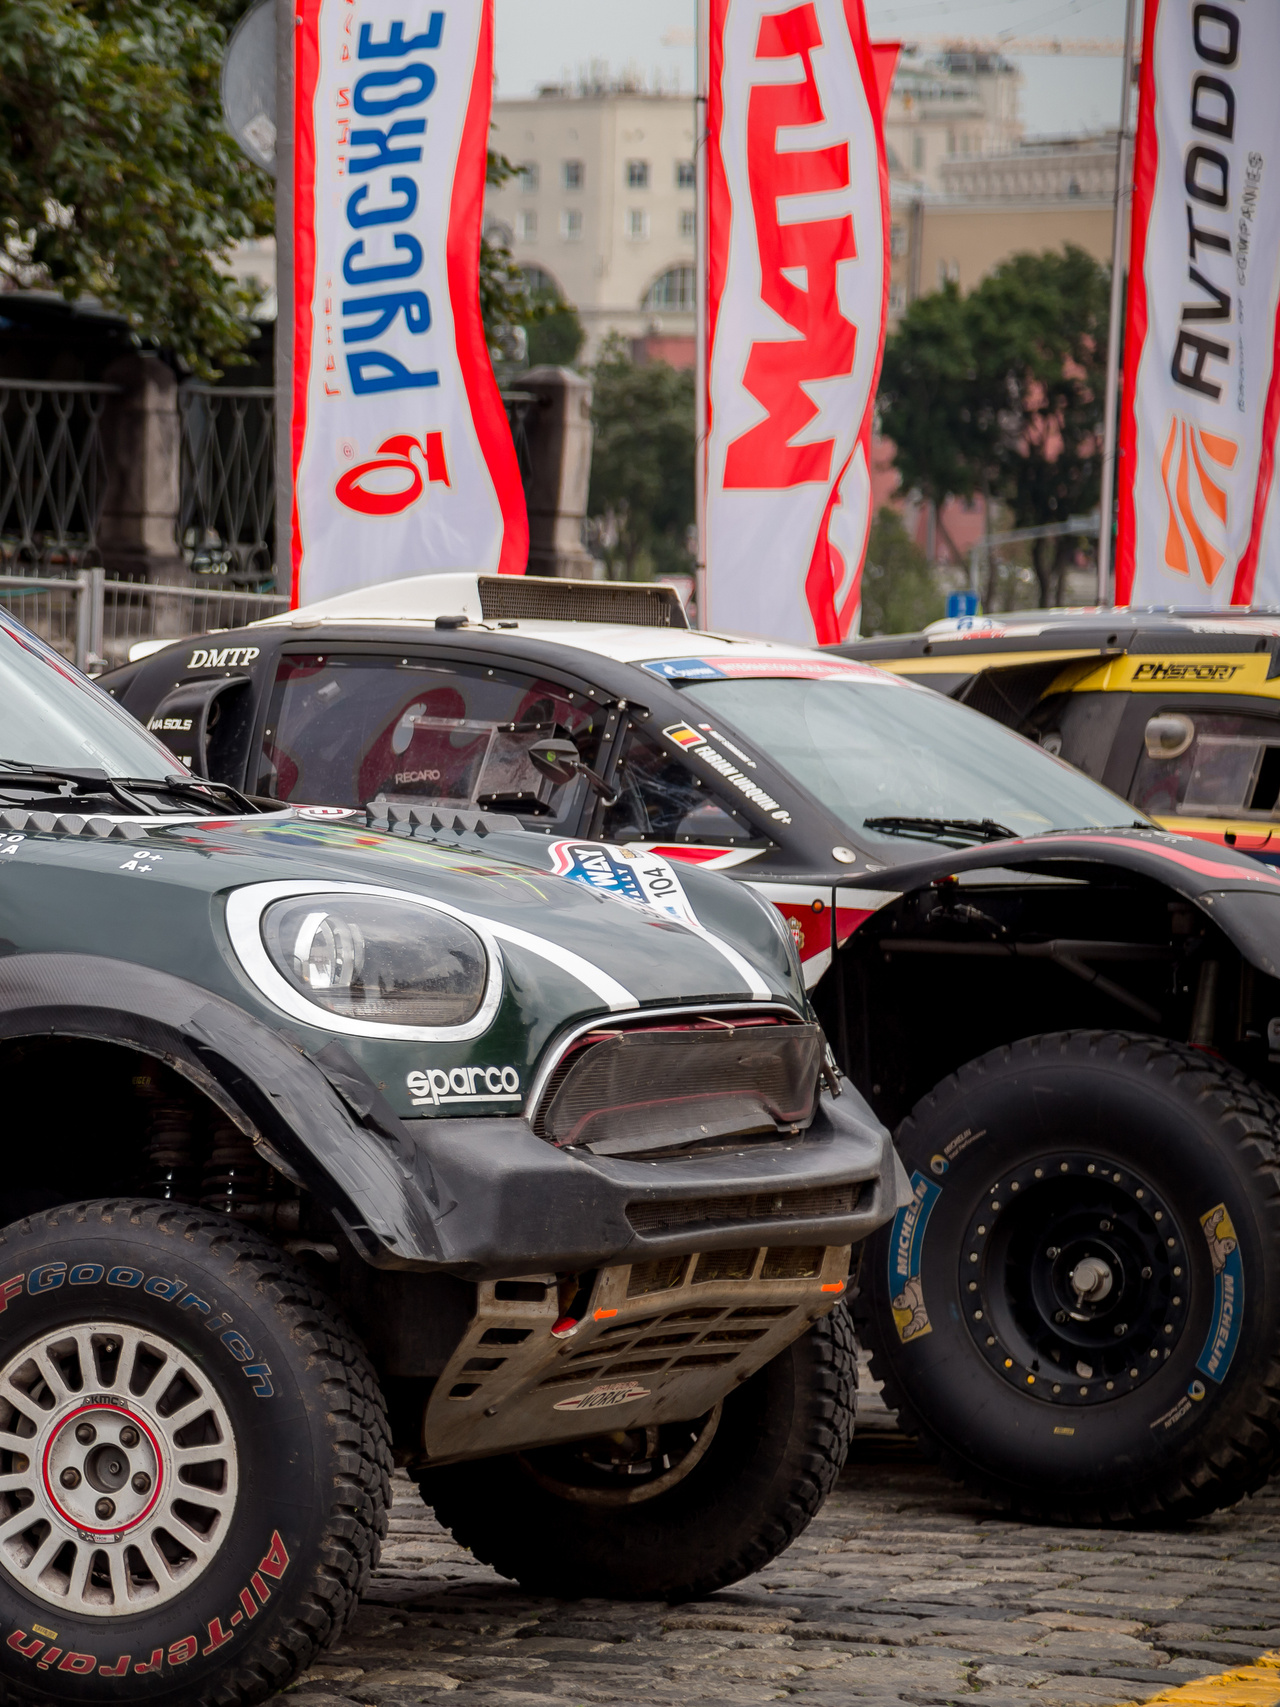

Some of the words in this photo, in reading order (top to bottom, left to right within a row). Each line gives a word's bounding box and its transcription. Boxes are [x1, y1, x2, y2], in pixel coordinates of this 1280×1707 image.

[342, 11, 446, 396] РУССКОЕ
[186, 646, 261, 669] DMTP
[395, 769, 441, 785] RECARO
[694, 745, 739, 777] FABIAN
[727, 772, 781, 812] LURQUIN
[119, 860, 153, 874] A+
[574, 848, 619, 888] WAY
[642, 867, 678, 898] 104
[407, 1065, 521, 1104] sparco
[1206, 1273, 1235, 1373] MICHELIN
[91, 1395, 119, 1405] KMC
[576, 1389, 633, 1409] WORKS
[6, 1530, 291, 1677] All-Terrain
